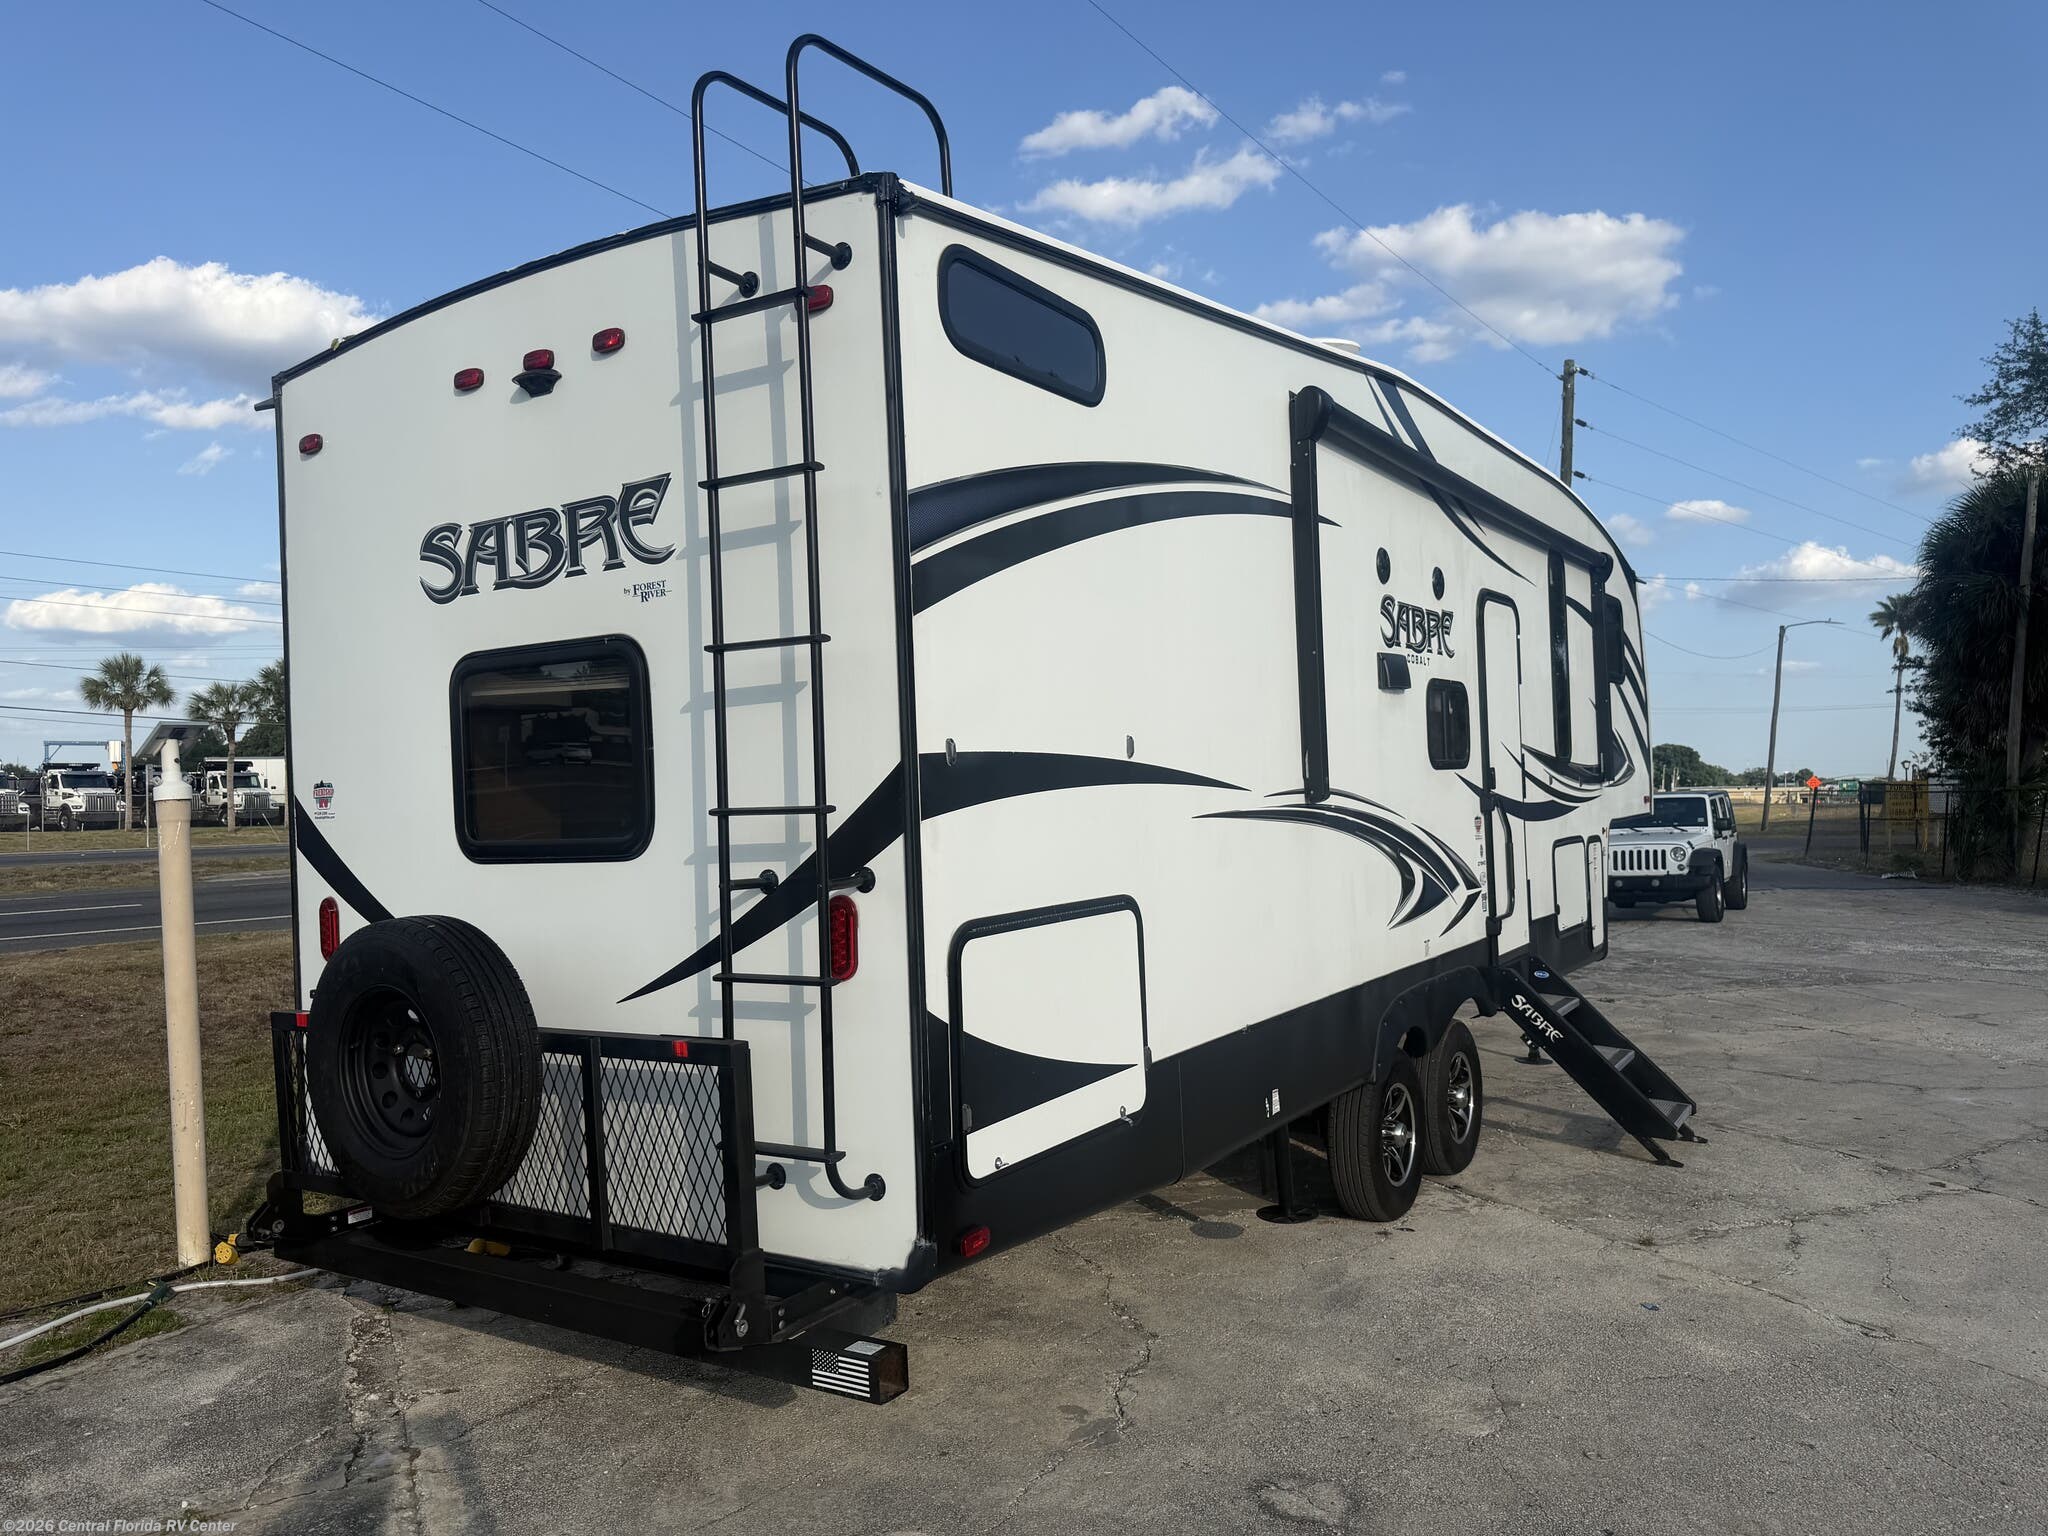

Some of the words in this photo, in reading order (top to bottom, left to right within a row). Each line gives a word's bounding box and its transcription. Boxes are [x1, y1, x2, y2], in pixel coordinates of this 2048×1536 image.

[419, 472, 677, 605] SABRE
[632, 579, 666, 596] FOREST
[640, 588, 666, 603] RIVER
[1380, 593, 1456, 659] SABRE
[1407, 654, 1431, 666] COBALT
[1511, 994, 1564, 1044] SABRE
